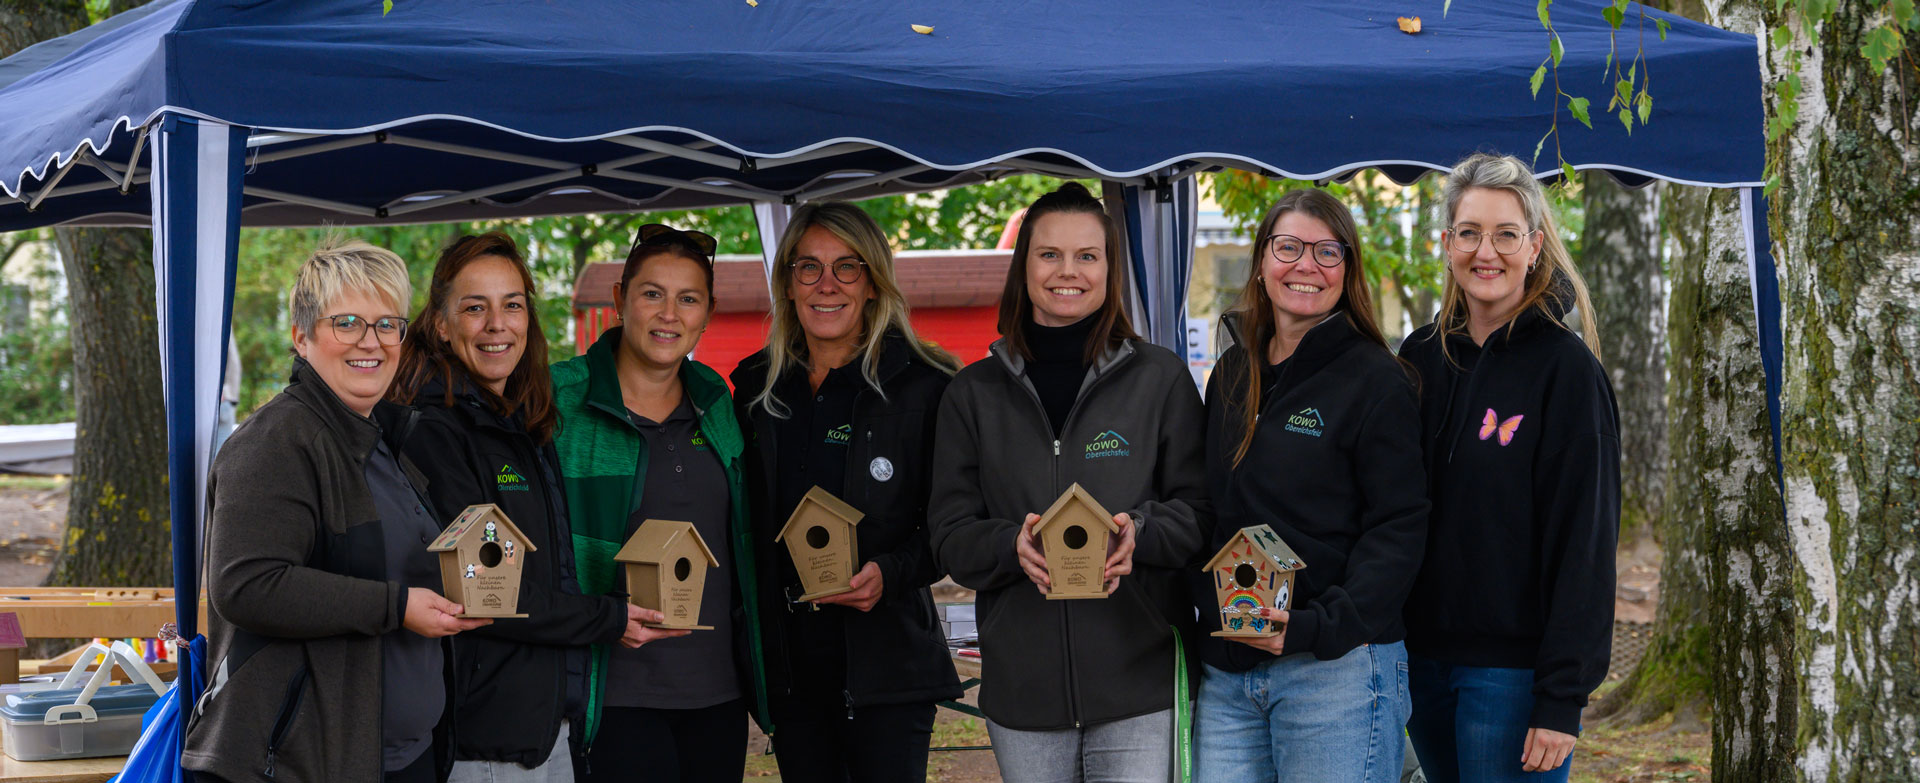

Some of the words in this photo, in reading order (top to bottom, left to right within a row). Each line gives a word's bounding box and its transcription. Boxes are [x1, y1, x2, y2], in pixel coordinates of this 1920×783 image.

[1287, 414, 1318, 428] KOWO
[827, 429, 851, 441] KOW
[1284, 423, 1322, 437] Obereichsfeld
[691, 437, 703, 446] KO
[1085, 439, 1119, 452] KOWO
[1085, 449, 1129, 459] Obereichsfeld
